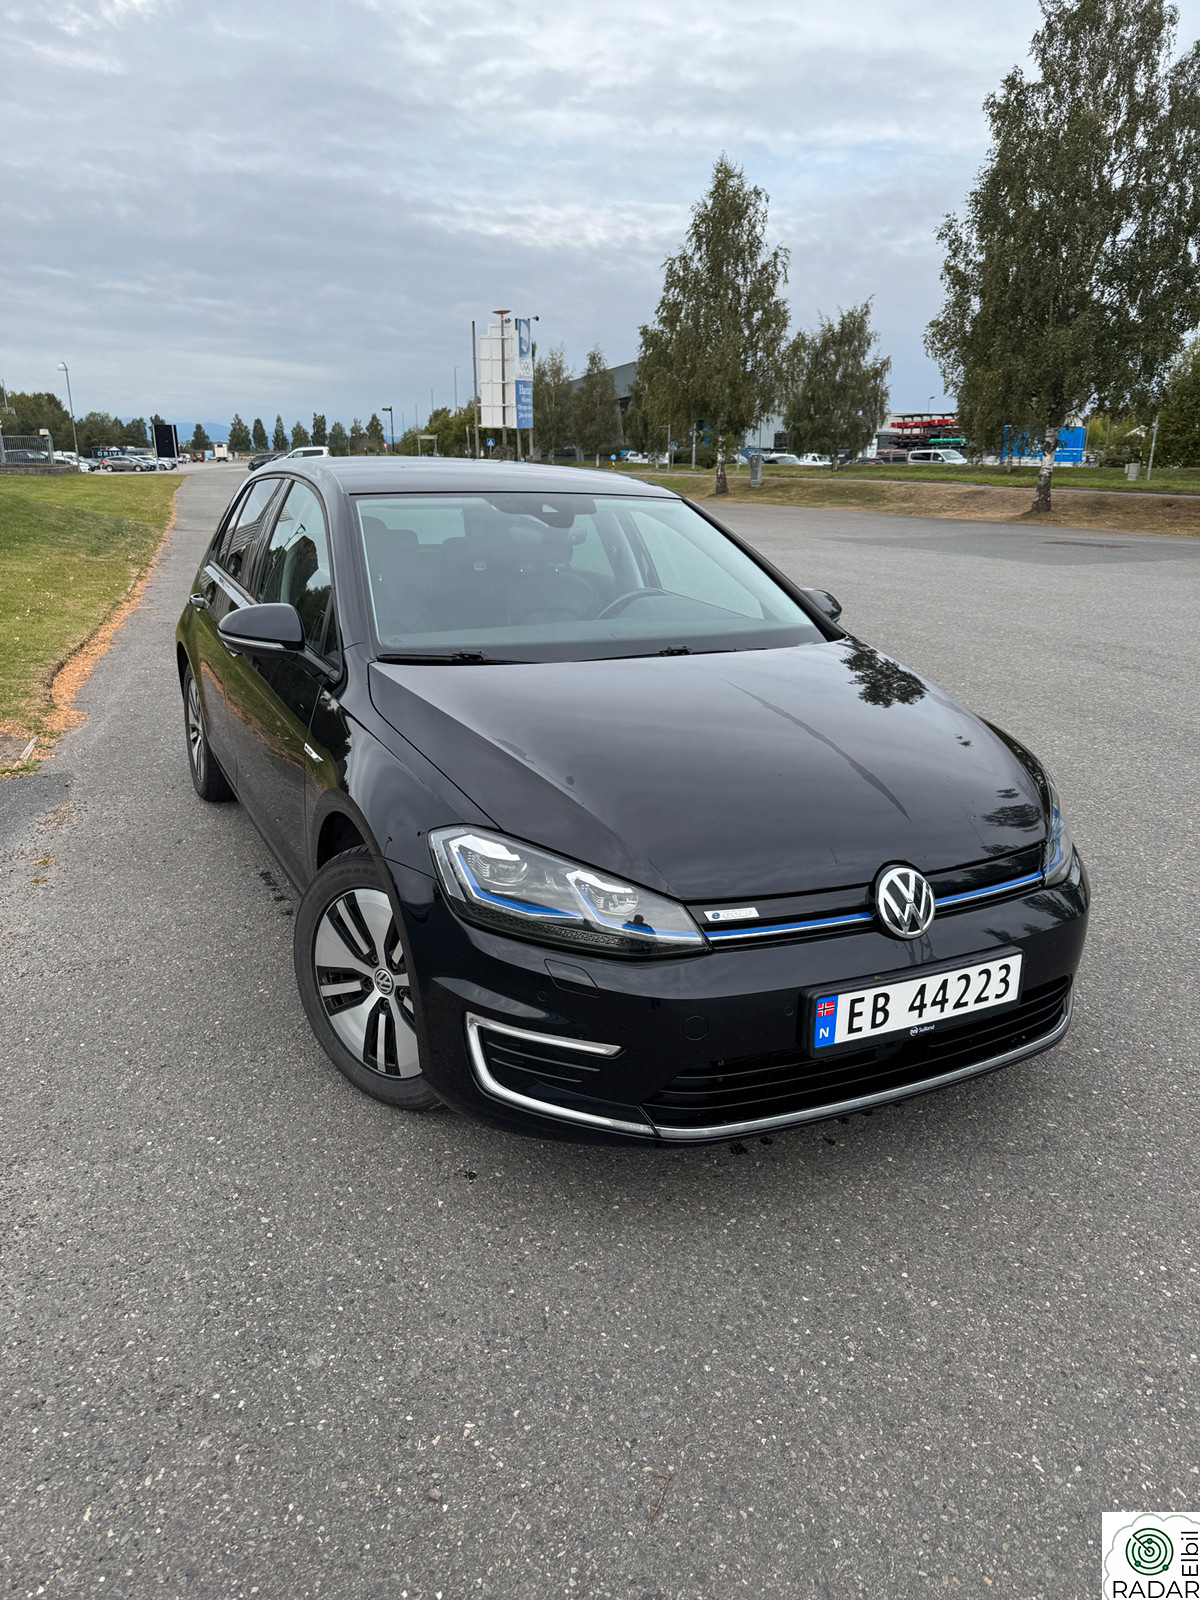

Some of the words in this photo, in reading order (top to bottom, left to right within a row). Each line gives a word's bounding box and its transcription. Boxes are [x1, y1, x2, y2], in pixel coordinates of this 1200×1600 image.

[847, 992, 891, 1035] EB
[908, 963, 1012, 1019] 44223
[819, 1027, 830, 1039] N
